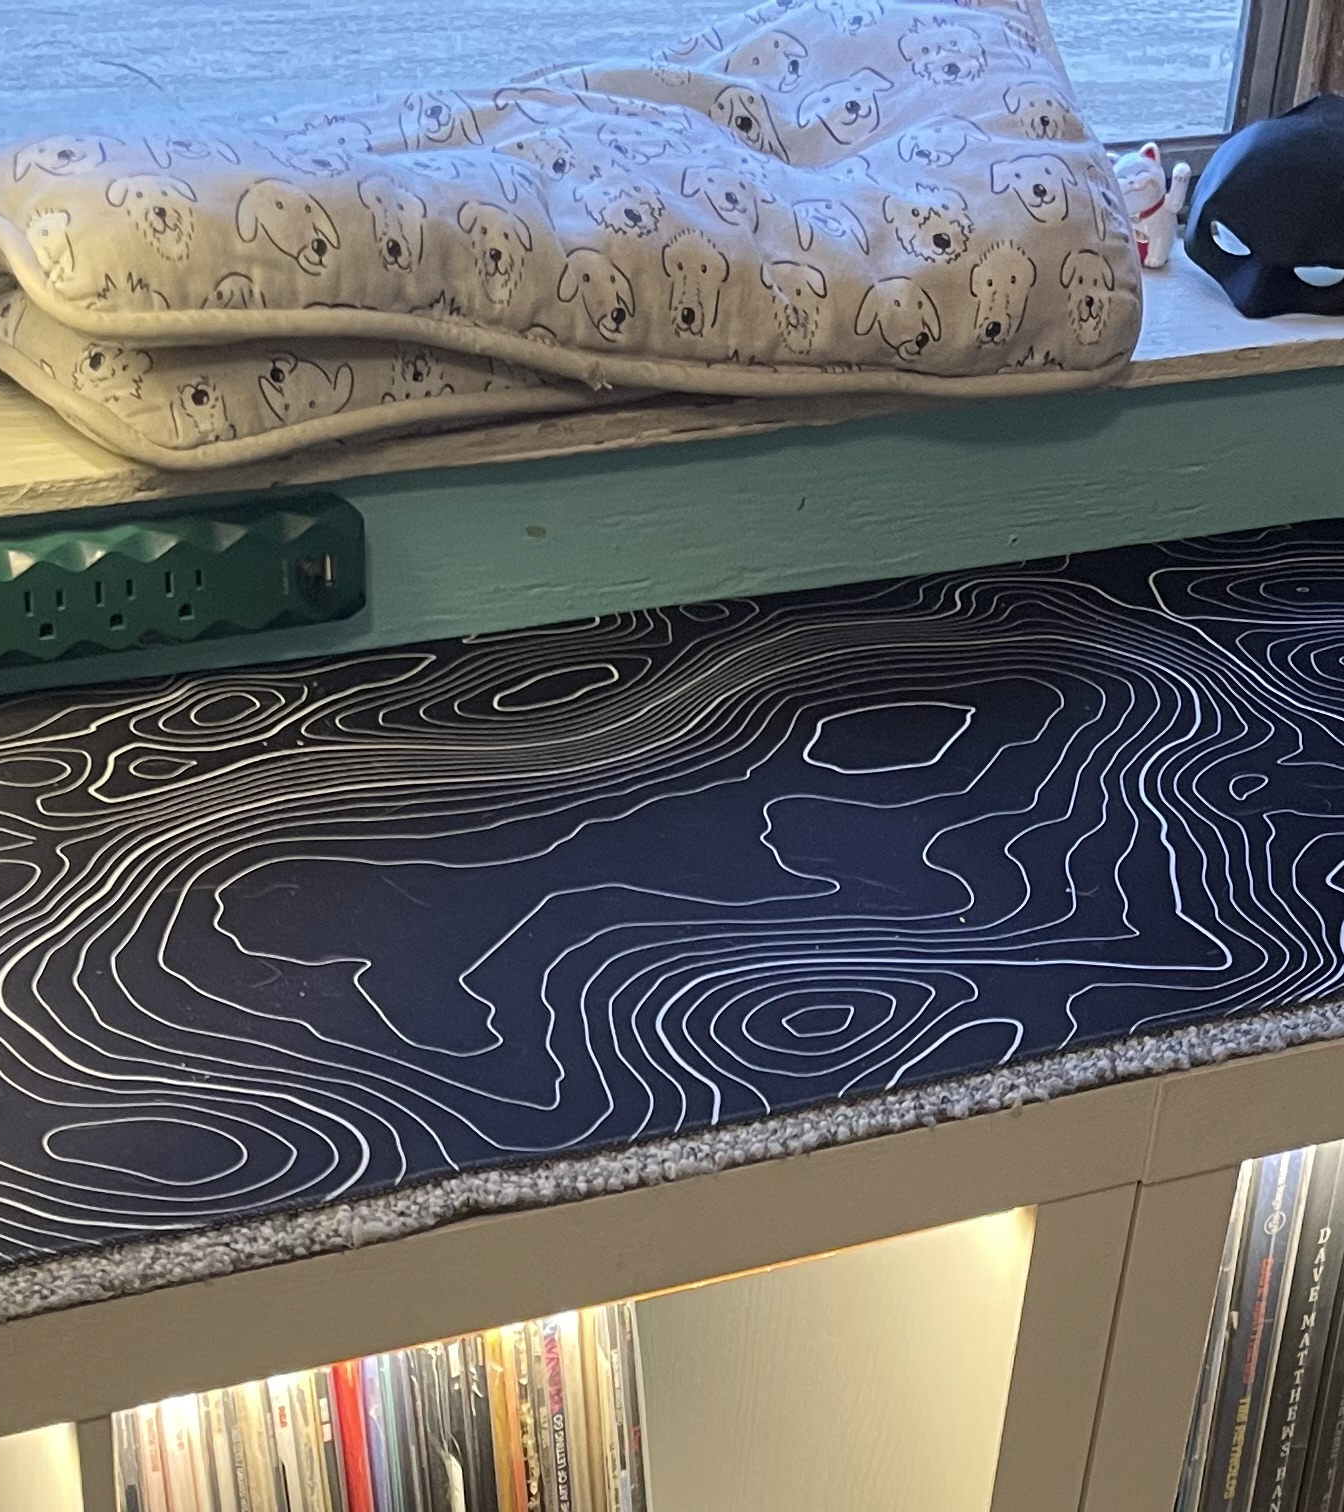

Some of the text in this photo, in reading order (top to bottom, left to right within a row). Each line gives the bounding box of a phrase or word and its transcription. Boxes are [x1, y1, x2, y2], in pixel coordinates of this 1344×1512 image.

[1309, 1226, 1331, 1303] DAVE
[1280, 1313, 1316, 1458] MATTHEWS
[552, 1413, 563, 1431] GO
[554, 1431, 566, 1469] LETTING
[556, 1469, 567, 1484] OF
[558, 1483, 568, 1501] ART
